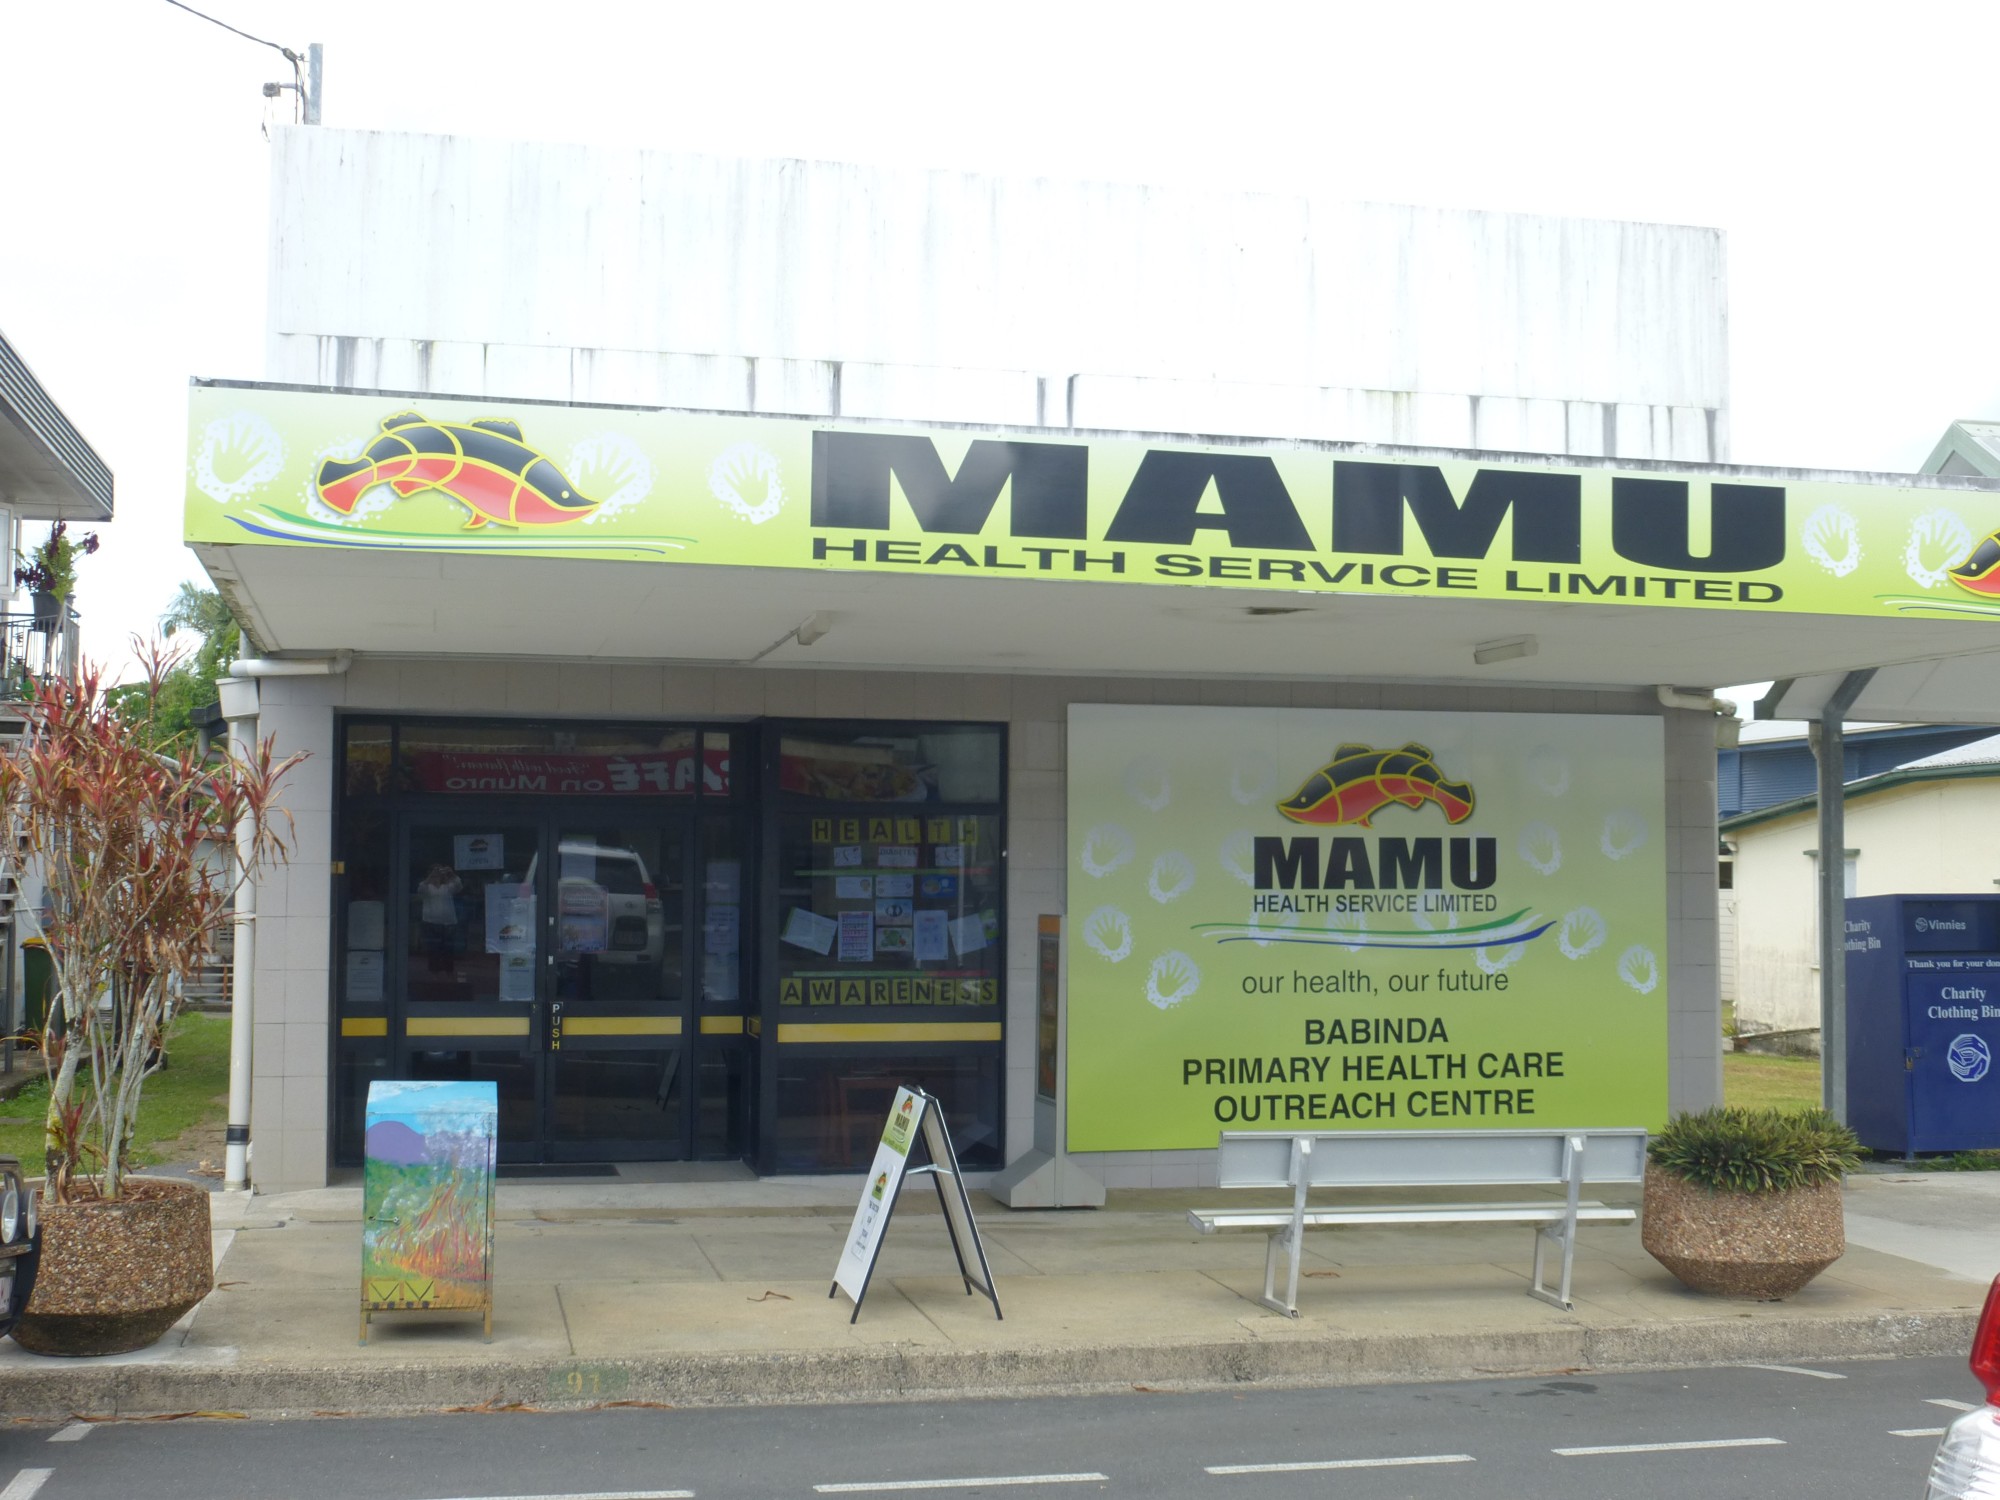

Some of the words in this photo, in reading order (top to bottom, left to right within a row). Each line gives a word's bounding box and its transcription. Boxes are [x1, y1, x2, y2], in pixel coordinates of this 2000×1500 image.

[811, 430, 1785, 573] MAMU
[813, 537, 1125, 573] HEALTH
[1156, 553, 1478, 589] SERVICE
[1506, 571, 1783, 603] LIMITED
[814, 822, 977, 841] HEALTH
[1254, 837, 1497, 890] MAMU
[1254, 895, 1328, 913] HEALTH
[1336, 895, 1418, 913] SERVICE
[1425, 894, 1497, 912] LIMITED
[1845, 920, 1871, 934] Charity
[1929, 920, 1966, 930] Vinnies
[1868, 937, 1881, 949] Bin
[1908, 960, 1934, 968] Thank
[1937, 961, 1950, 969] you
[1966, 961, 1984, 969] your
[784, 981, 997, 1001] AWARENESS
[1243, 975, 1285, 994] our
[1294, 969, 1378, 997] health,
[1389, 974, 1430, 993] our
[1437, 969, 1508, 992] future
[1941, 987, 1986, 1002] Charity
[1928, 1006, 1978, 1021] Clothing
[1981, 1005, 2000, 1017] Bin
[552, 1004, 560, 1049] PUSH
[1306, 1018, 1449, 1045] BABINDA
[1184, 1057, 1331, 1085] PRIMARY
[1343, 1054, 1466, 1081] HEALTH
[1478, 1052, 1564, 1078] CARE
[1214, 1092, 1395, 1122] OUTREACH
[1407, 1089, 1535, 1118] CENTRE
